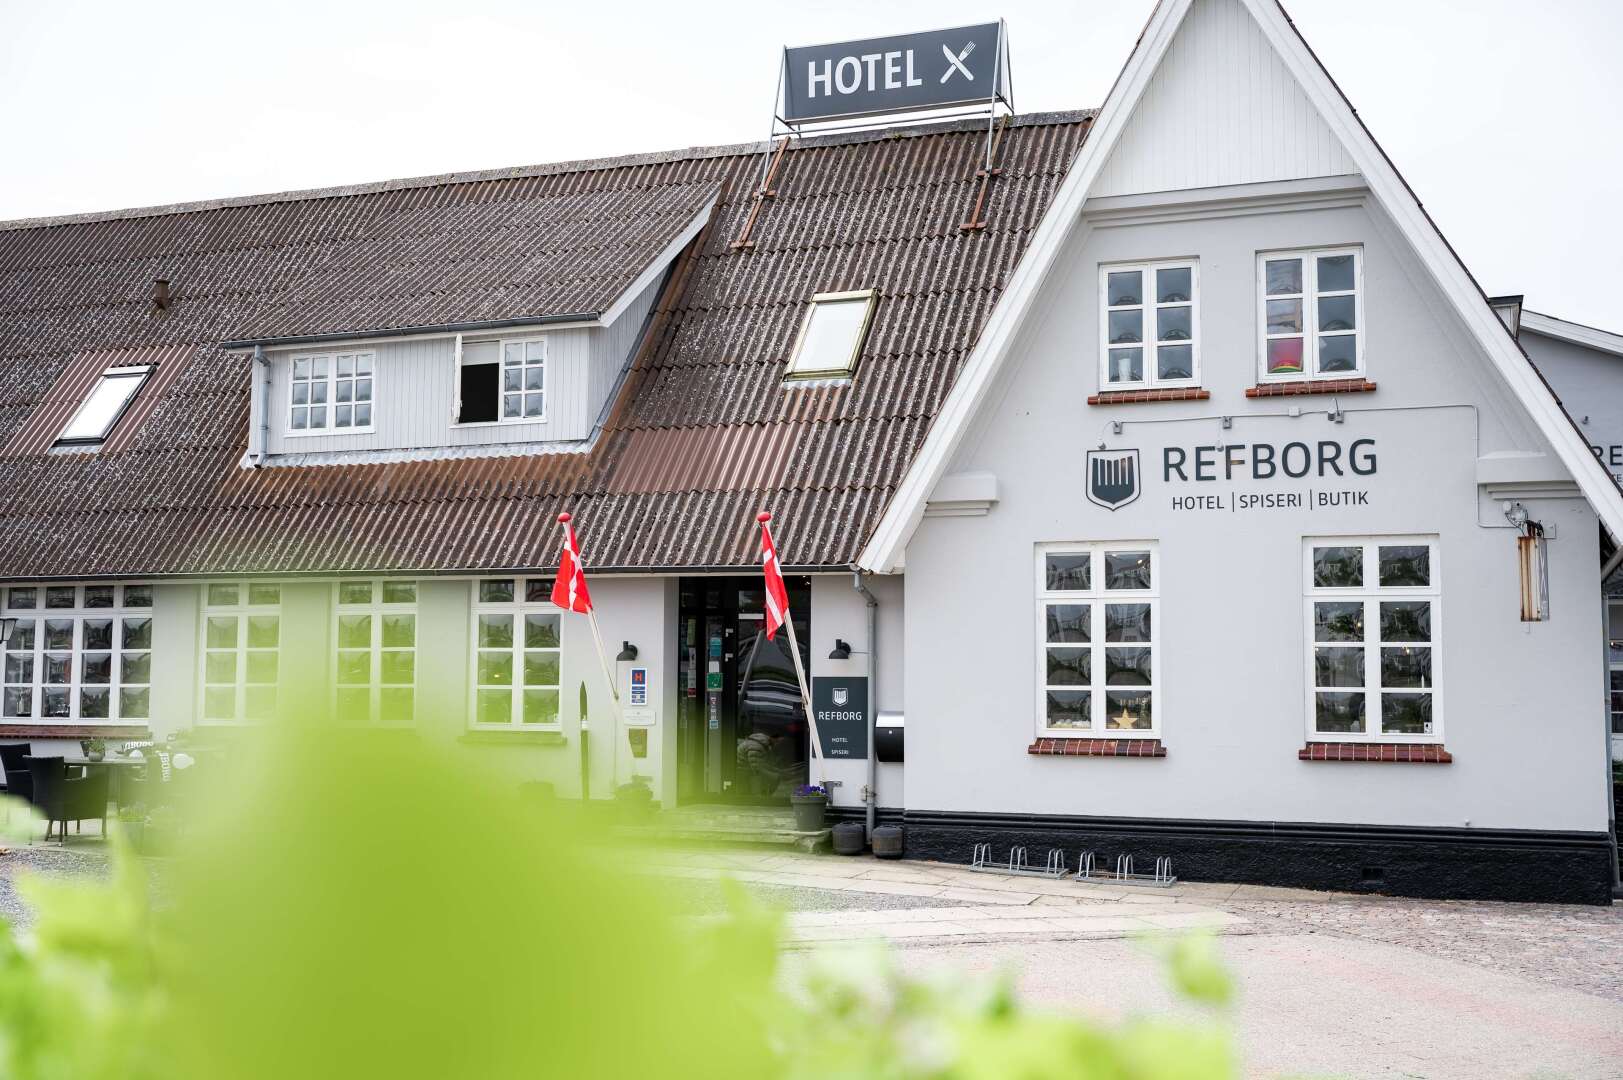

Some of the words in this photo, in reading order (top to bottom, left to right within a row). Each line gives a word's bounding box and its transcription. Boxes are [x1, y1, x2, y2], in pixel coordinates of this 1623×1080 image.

[808, 49, 923, 98] HOTEL
[1163, 438, 1377, 482] REFBORG
[1172, 495, 1225, 511] HOTEL
[1239, 493, 1302, 509] SPISERI
[1318, 490, 1369, 506] BUTIK
[818, 711, 863, 721] REFBORG
